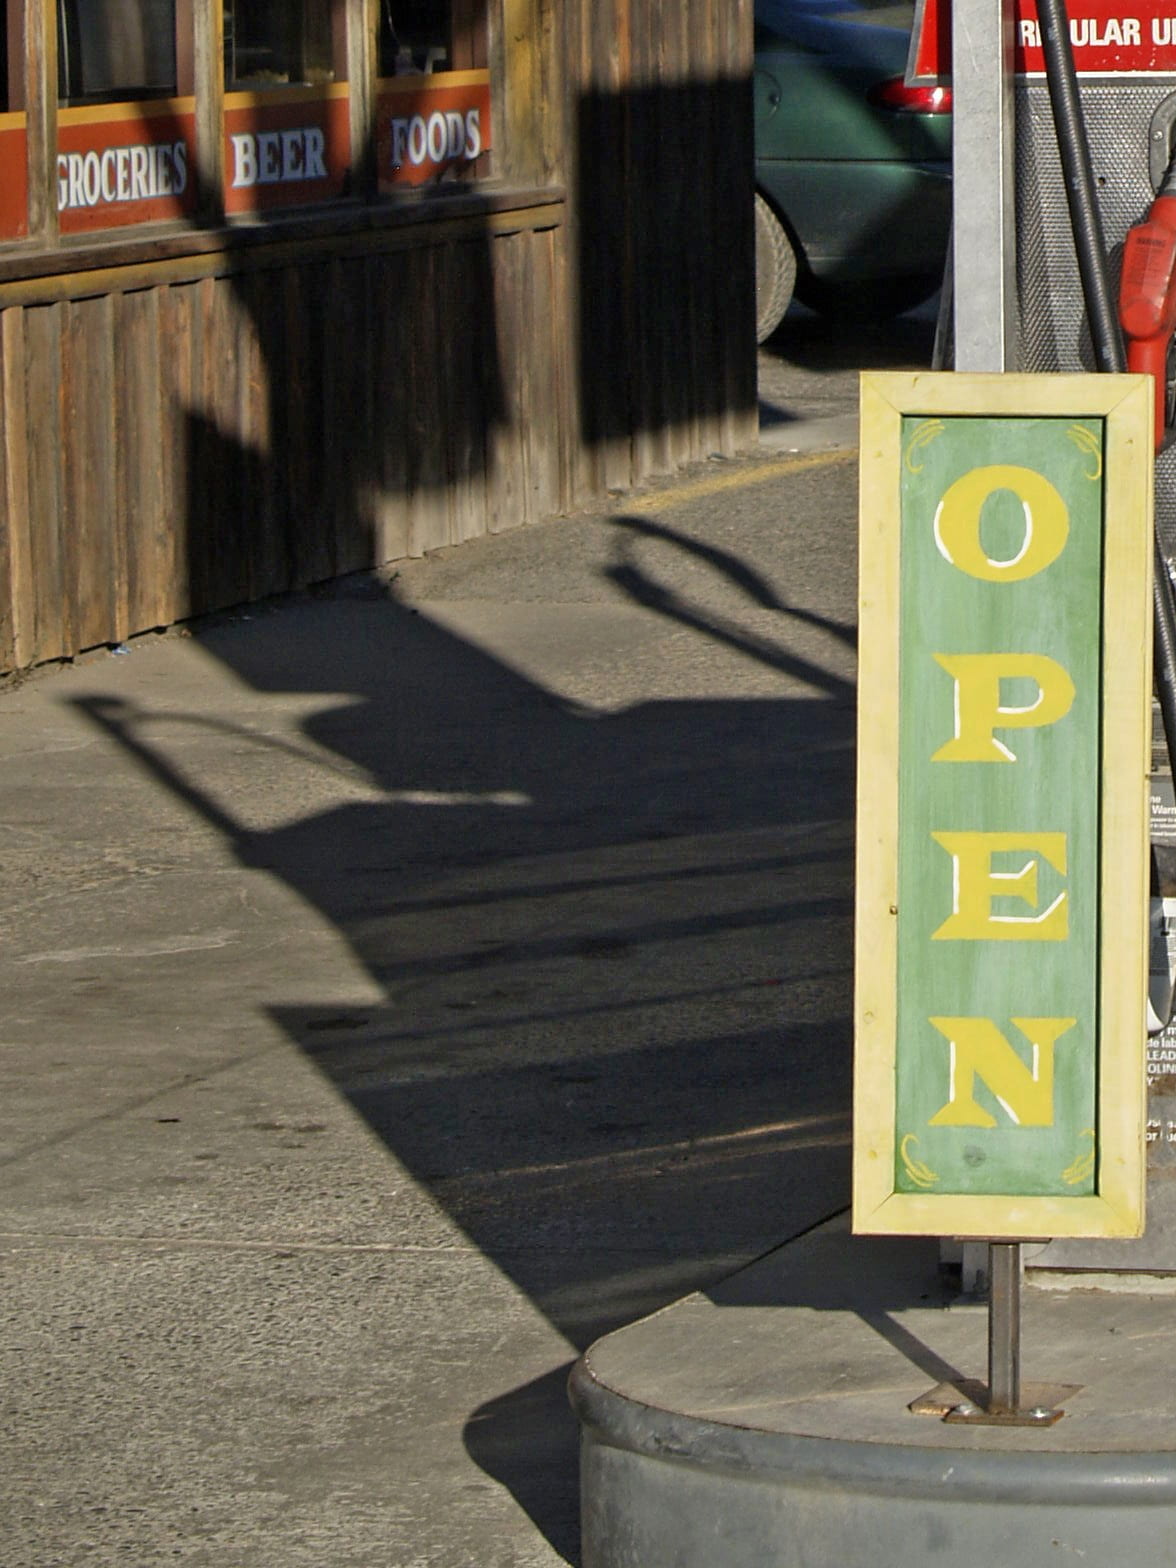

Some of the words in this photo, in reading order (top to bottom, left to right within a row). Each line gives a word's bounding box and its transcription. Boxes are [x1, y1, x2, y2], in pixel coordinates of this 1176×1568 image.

[1019, 19, 1141, 47] RULAR
[56, 140, 188, 212] GROCERIES
[230, 127, 329, 188] BEER
[392, 108, 482, 168] FOODS
[929, 465, 1078, 1127] OPEN
